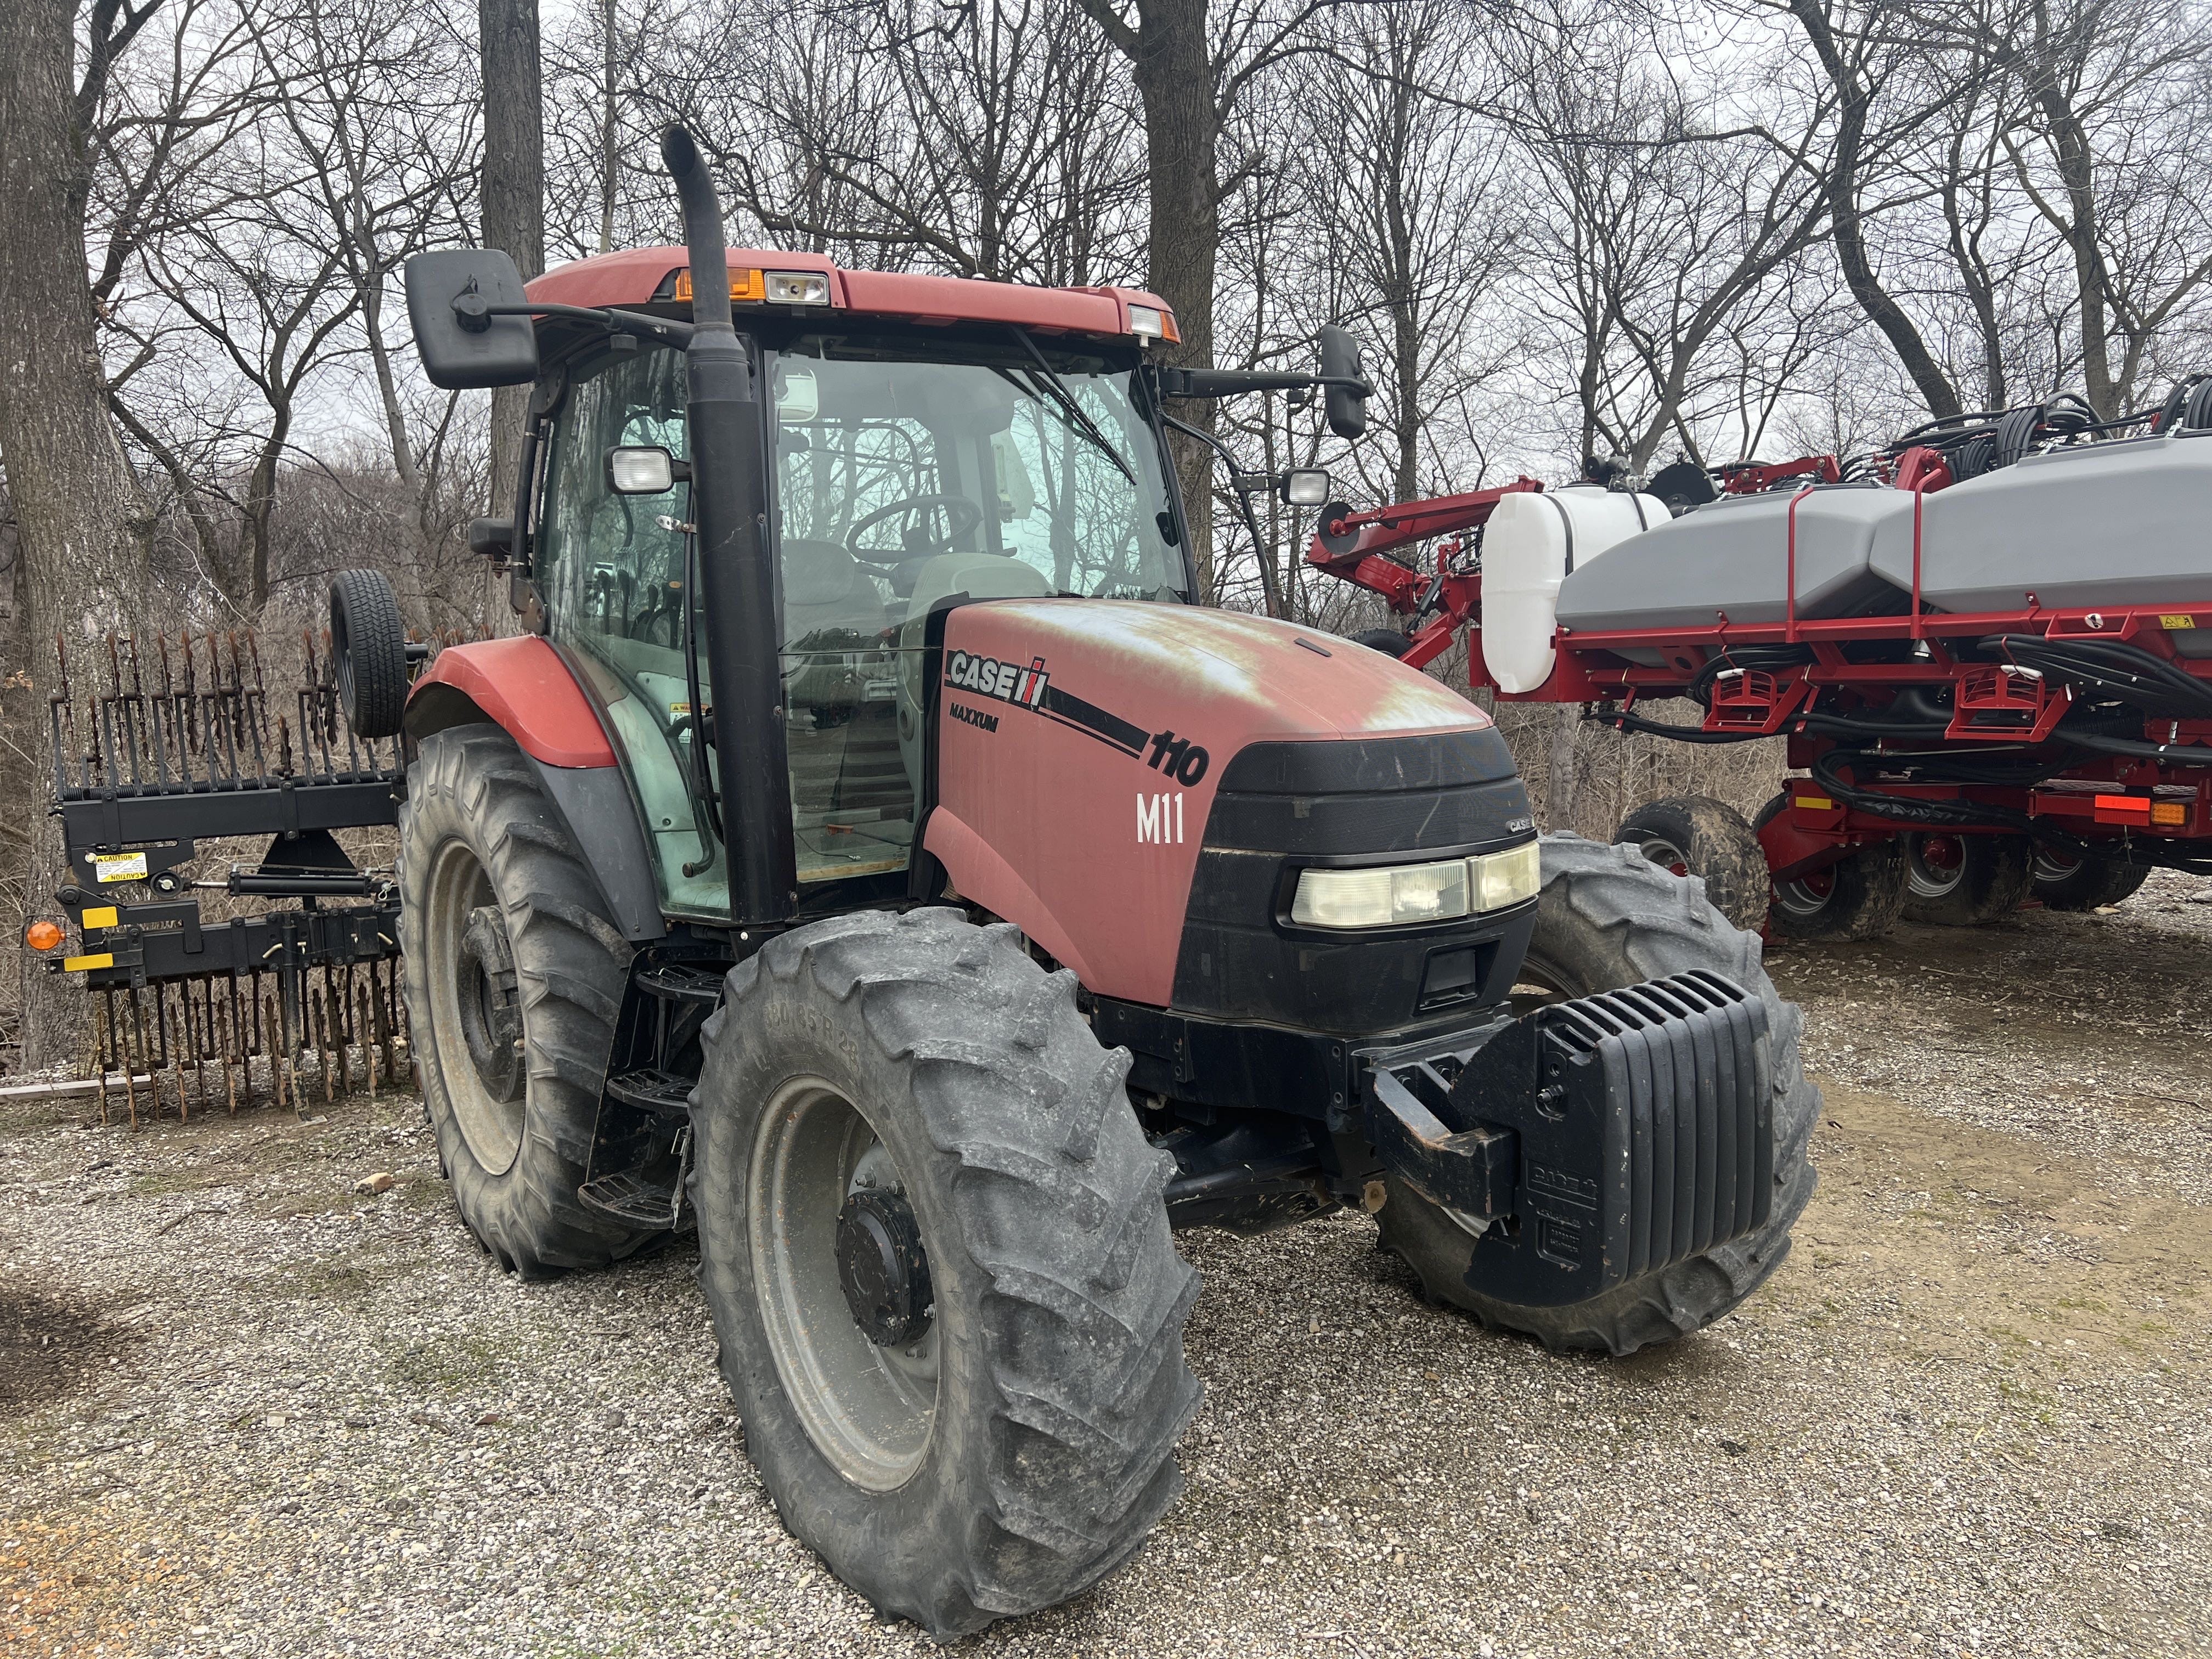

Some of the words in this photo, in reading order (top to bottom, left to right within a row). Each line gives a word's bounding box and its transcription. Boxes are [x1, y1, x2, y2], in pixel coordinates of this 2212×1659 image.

[950, 652, 1018, 698] CASE
[949, 702, 1000, 733] MAXXUM
[1147, 730, 1210, 787] 110
[1137, 792, 1183, 844] M11
[1510, 818, 1531, 832] CASE
